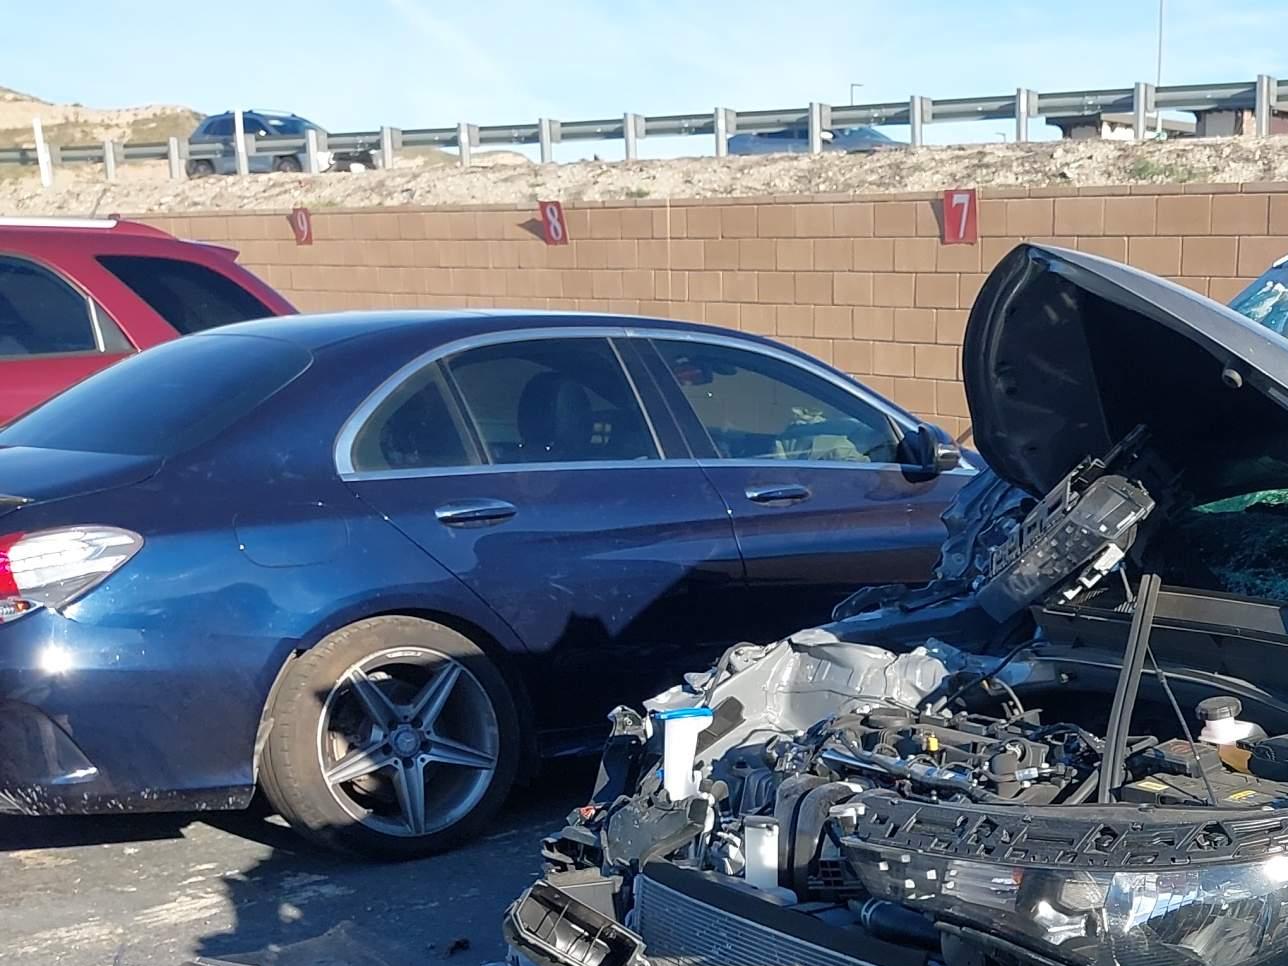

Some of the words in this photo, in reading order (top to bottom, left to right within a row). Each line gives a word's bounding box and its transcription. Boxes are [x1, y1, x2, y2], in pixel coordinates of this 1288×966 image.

[297, 211, 308, 241] 9
[546, 204, 562, 241] 8
[951, 194, 970, 239] 7
